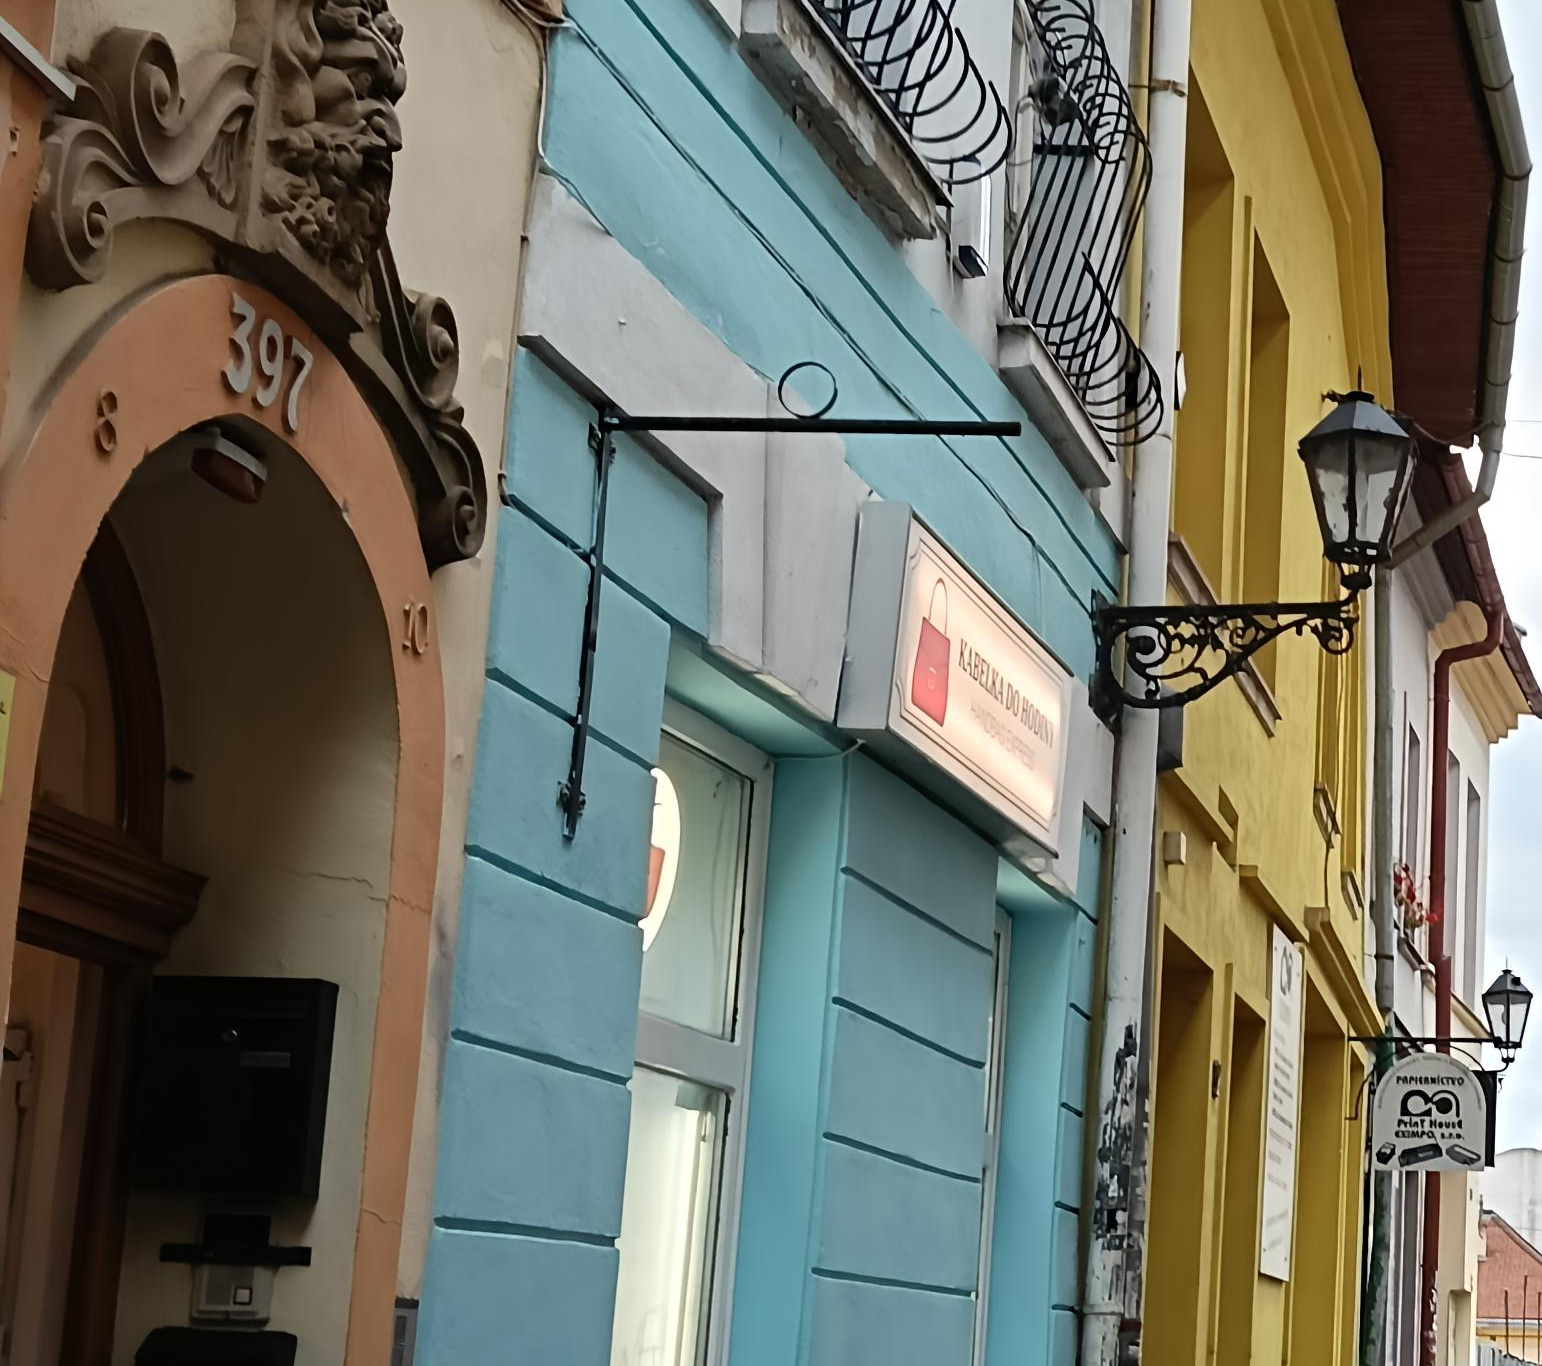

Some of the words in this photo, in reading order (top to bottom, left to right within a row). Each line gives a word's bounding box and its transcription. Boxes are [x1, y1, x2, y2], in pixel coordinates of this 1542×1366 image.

[221, 291, 314, 433] 397
[94, 390, 118, 453] 8
[403, 599, 430, 655] 10
[959, 637, 1004, 705] KABELKA
[1006, 683, 1020, 717] DO
[1020, 696, 1054, 749] HODINY
